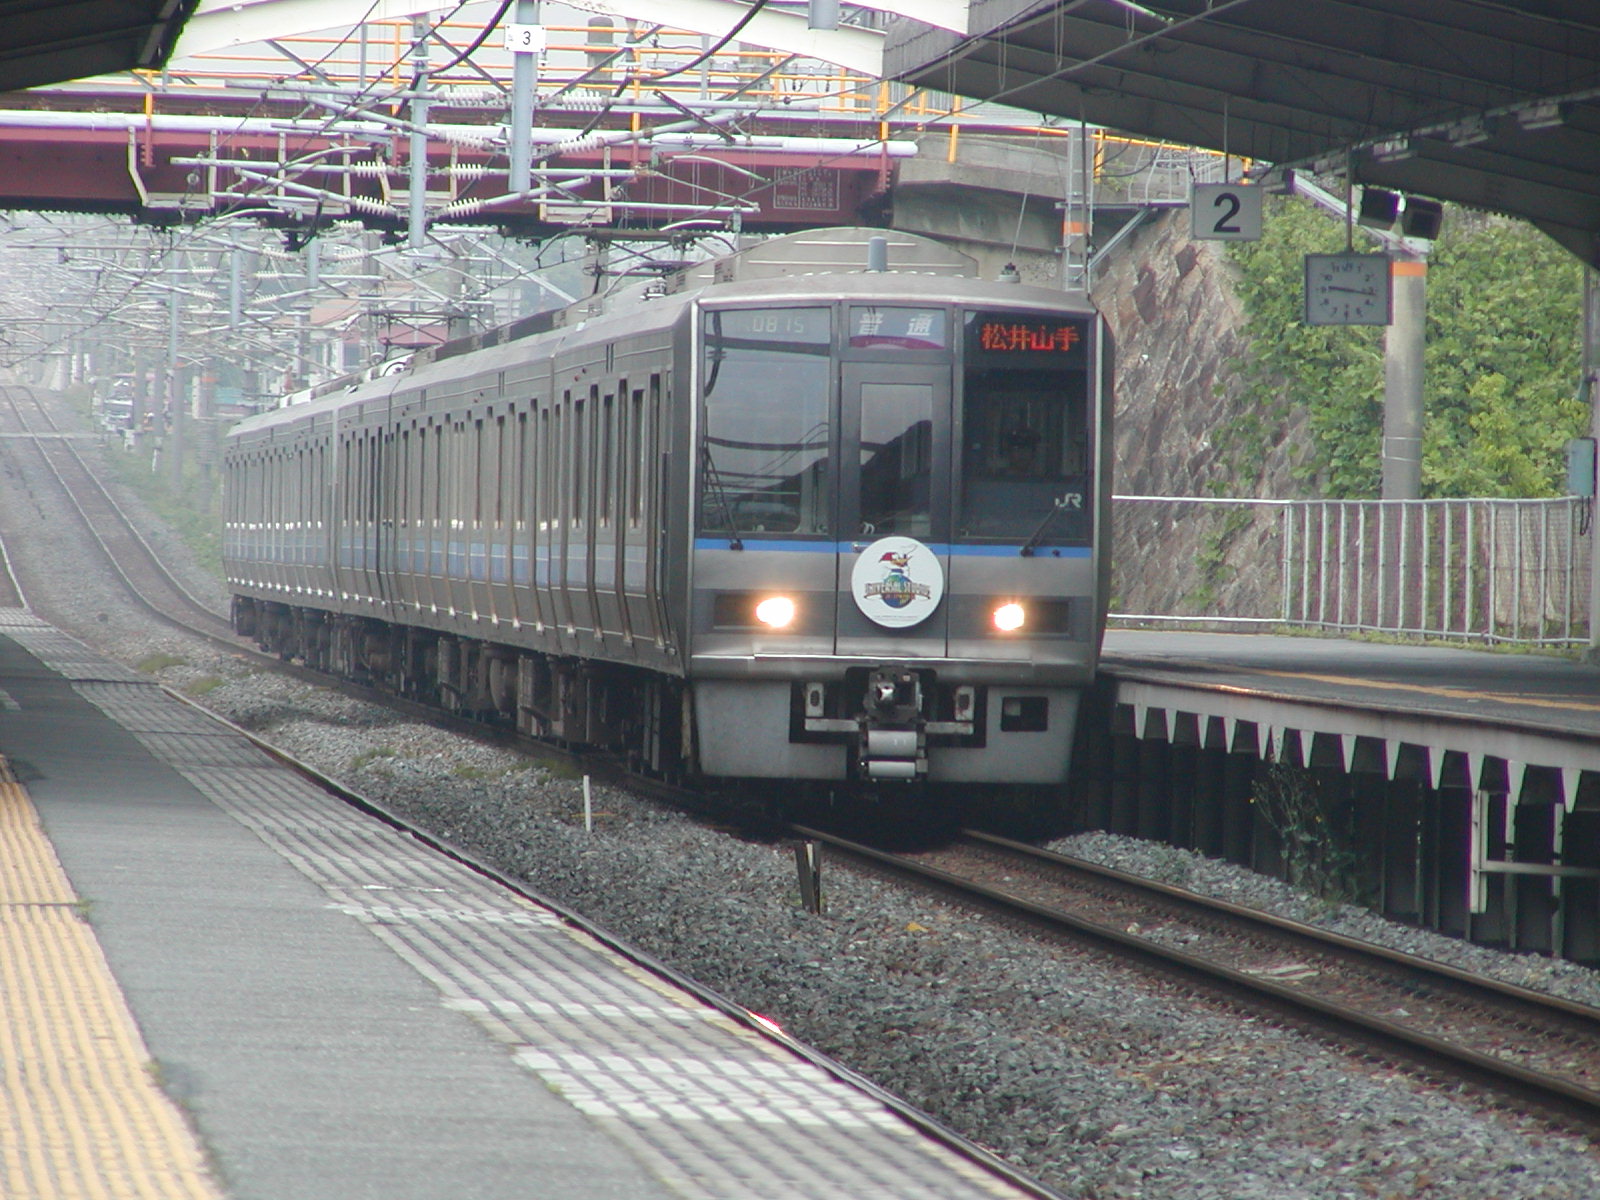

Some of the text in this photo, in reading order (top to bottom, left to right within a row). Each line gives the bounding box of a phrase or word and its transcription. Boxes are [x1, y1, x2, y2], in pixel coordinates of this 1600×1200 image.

[522, 30, 531, 46] 3
[1213, 192, 1241, 233] 2
[858, 312, 934, 336] 普通
[982, 323, 1080, 351] 松井山手
[1055, 493, 1082, 508] JR
